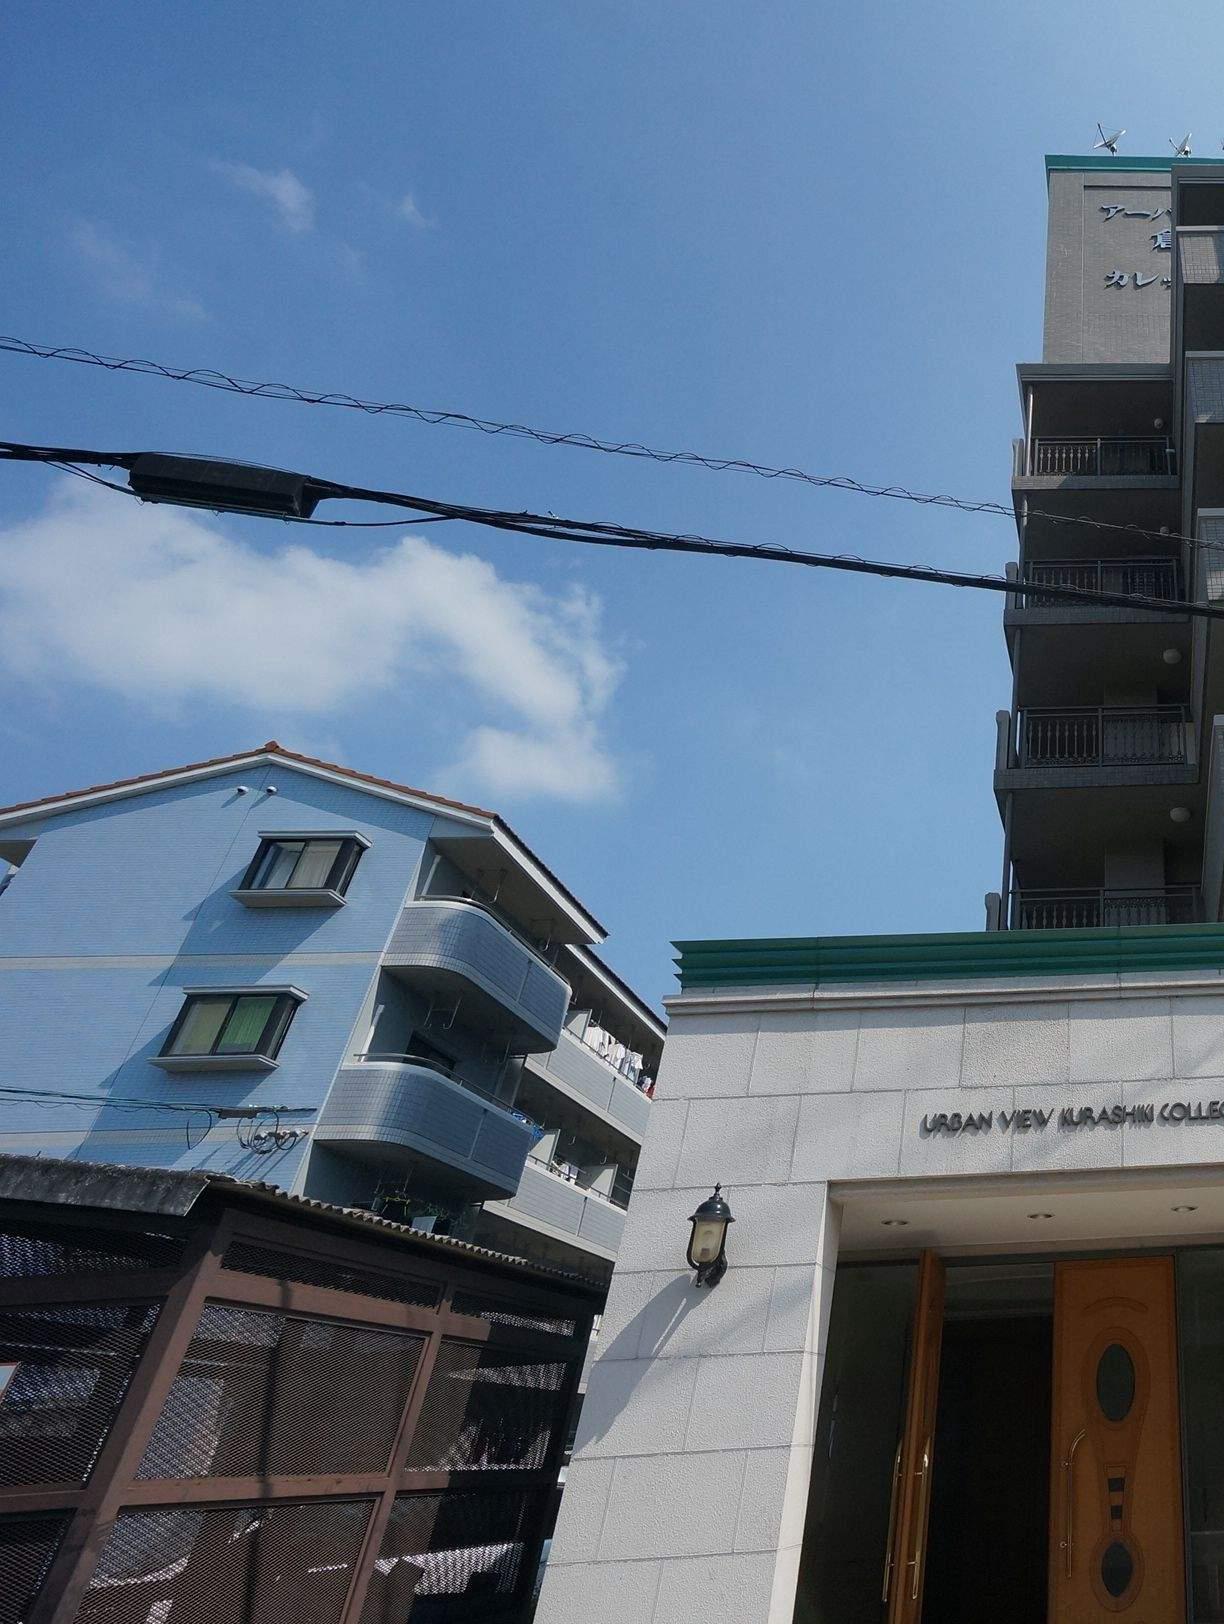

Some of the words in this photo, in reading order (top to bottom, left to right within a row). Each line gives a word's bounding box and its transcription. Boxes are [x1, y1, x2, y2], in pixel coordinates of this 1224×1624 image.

[923, 1111, 993, 1134] URBAN
[999, 1109, 1053, 1131] VIEW
[1060, 1104, 1154, 1128] KURASHIKI
